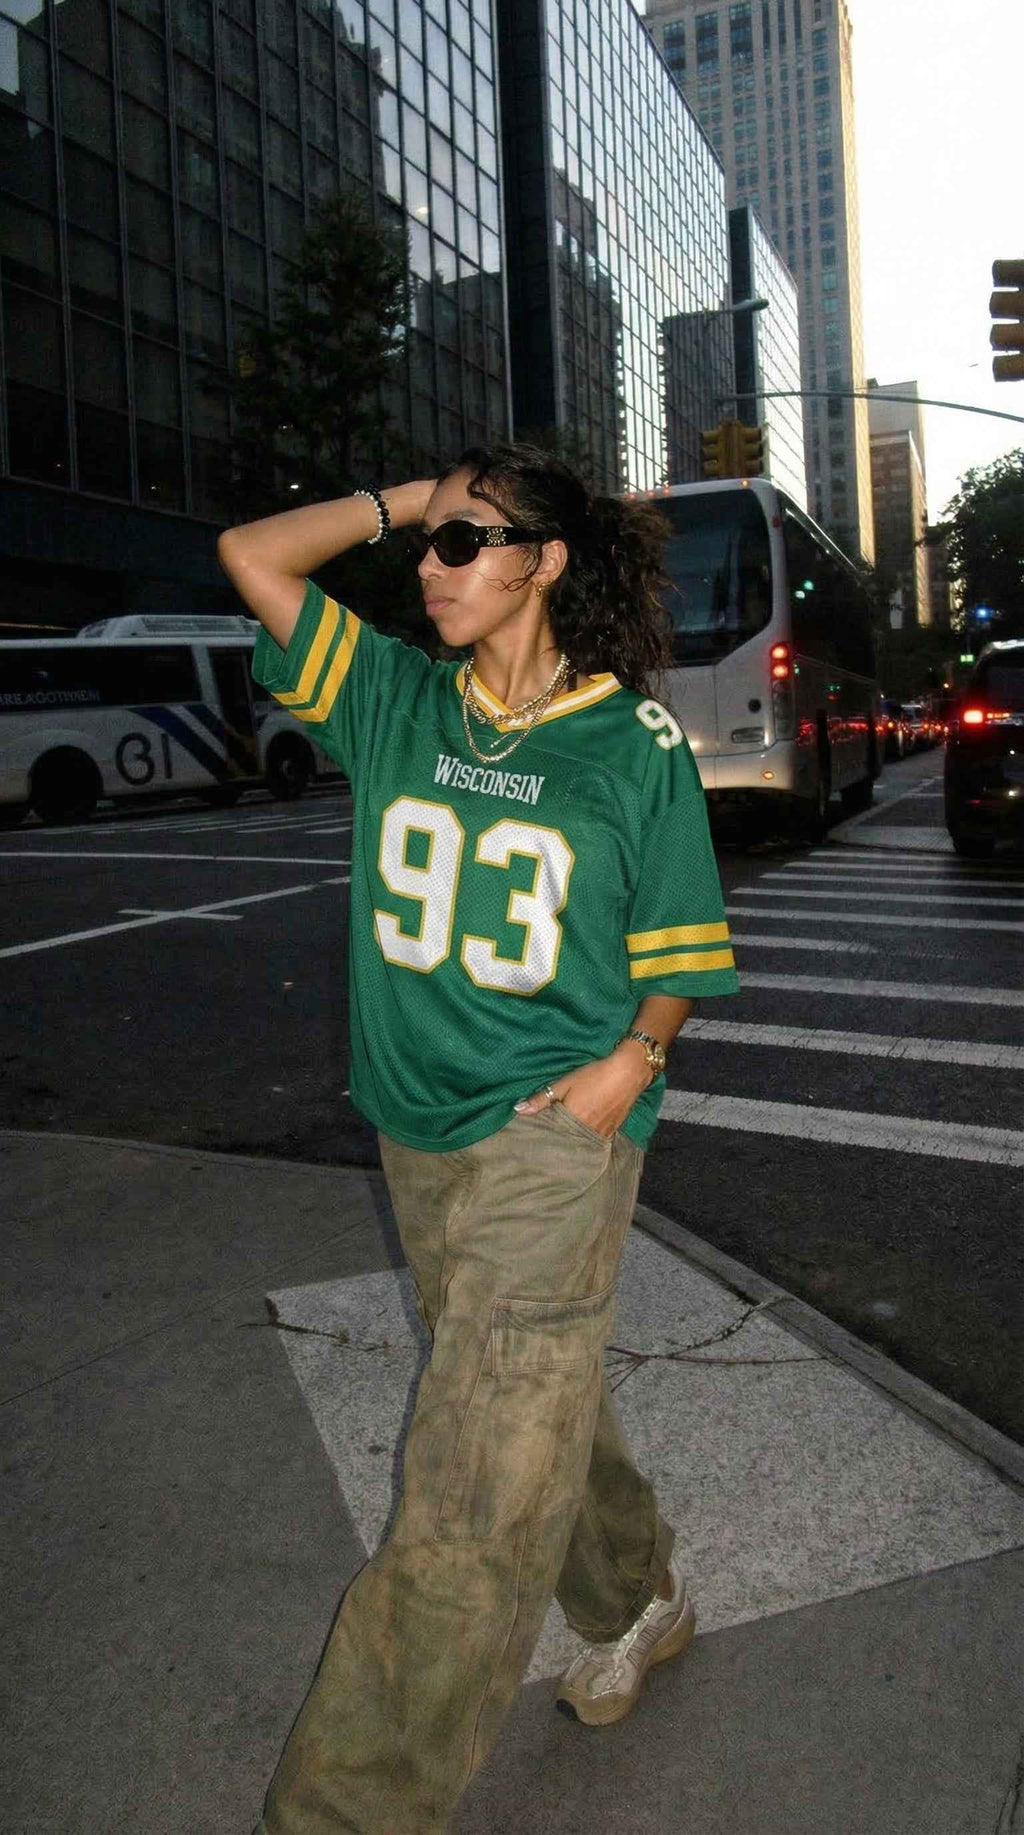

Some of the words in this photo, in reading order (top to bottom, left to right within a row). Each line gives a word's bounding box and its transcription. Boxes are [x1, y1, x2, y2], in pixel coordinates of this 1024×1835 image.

[635, 699, 684, 750] 9
[433, 754, 545, 805] WISCONSIN
[373, 795, 576, 997] 93
